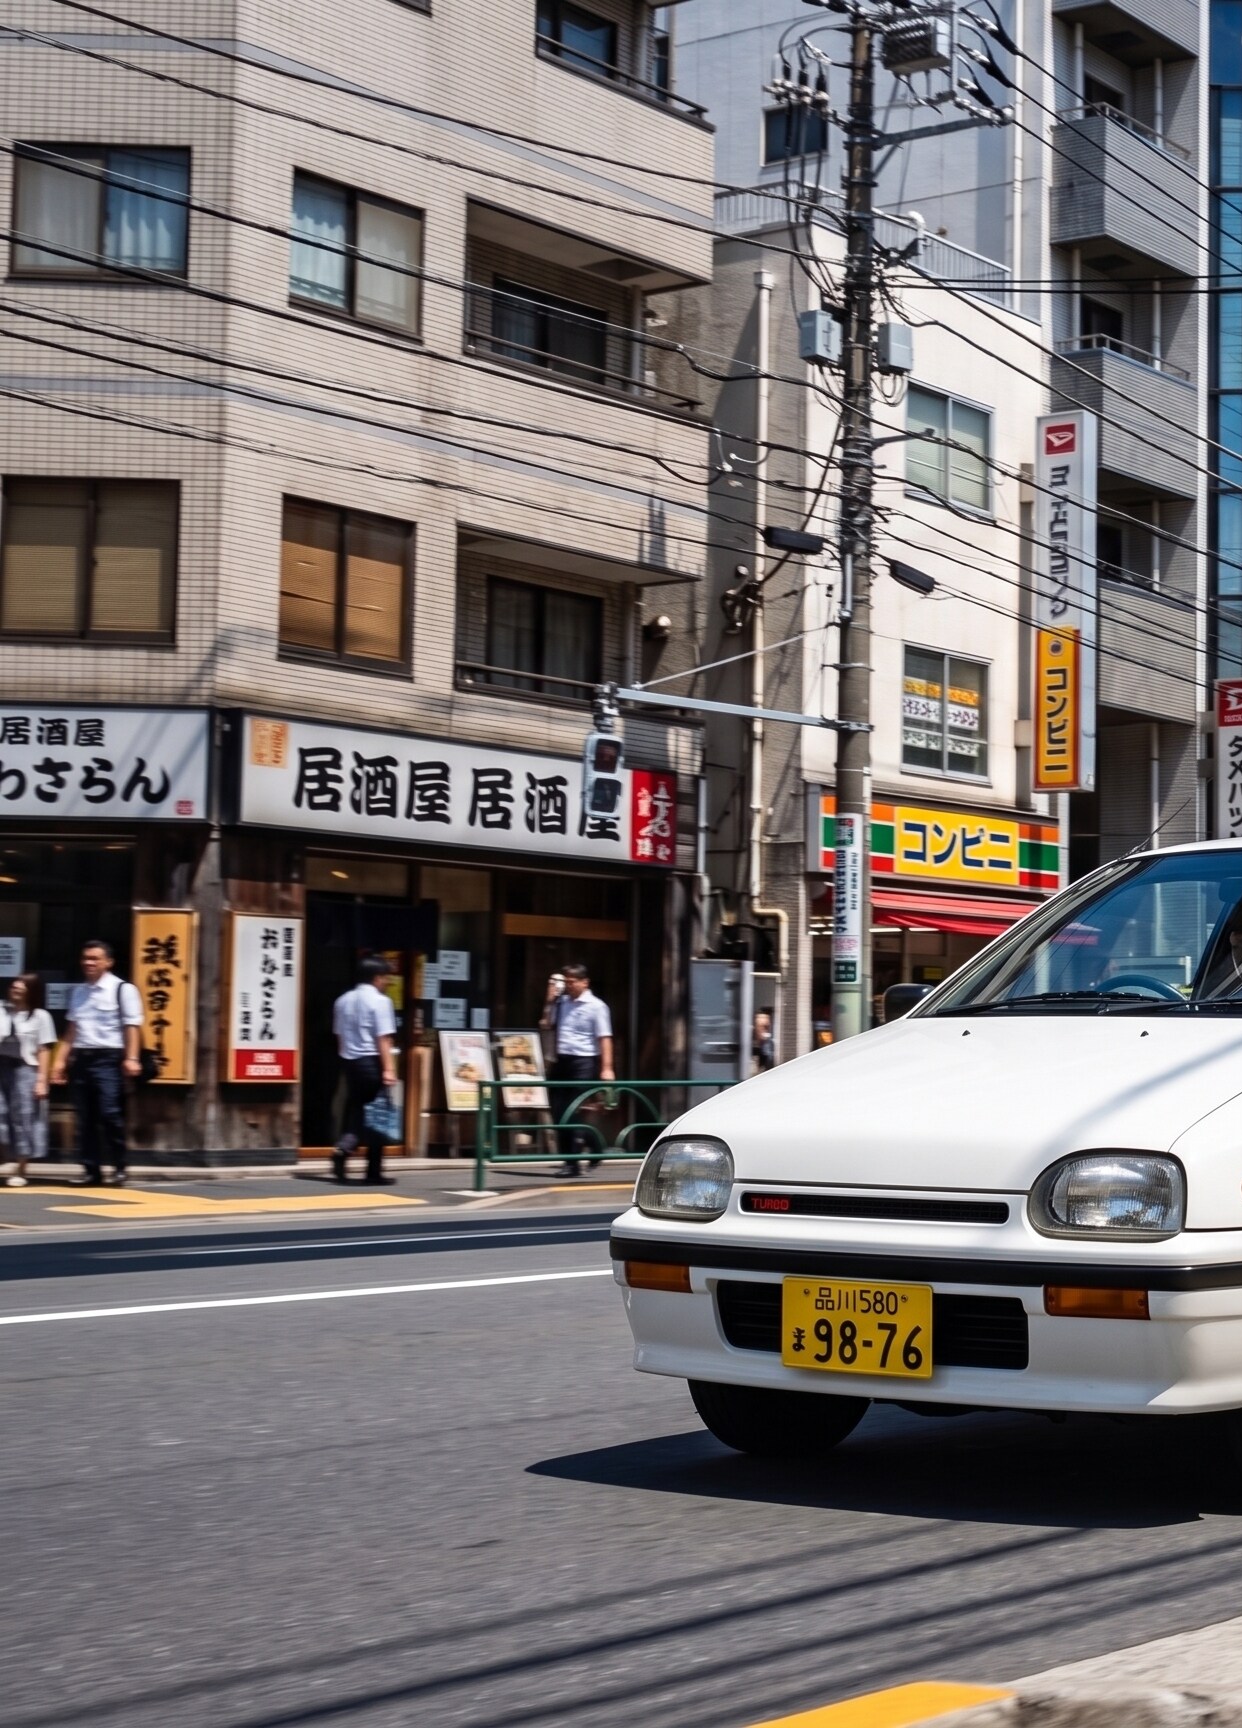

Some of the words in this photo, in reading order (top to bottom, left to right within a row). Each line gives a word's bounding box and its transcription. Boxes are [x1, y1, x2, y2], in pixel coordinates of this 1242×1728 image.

[0, 716, 105, 747] 居酒屋
[294, 747, 451, 825] 居酒屋
[815, 1287, 899, 1315] 品川580
[814, 1318, 923, 1370] 98-76
